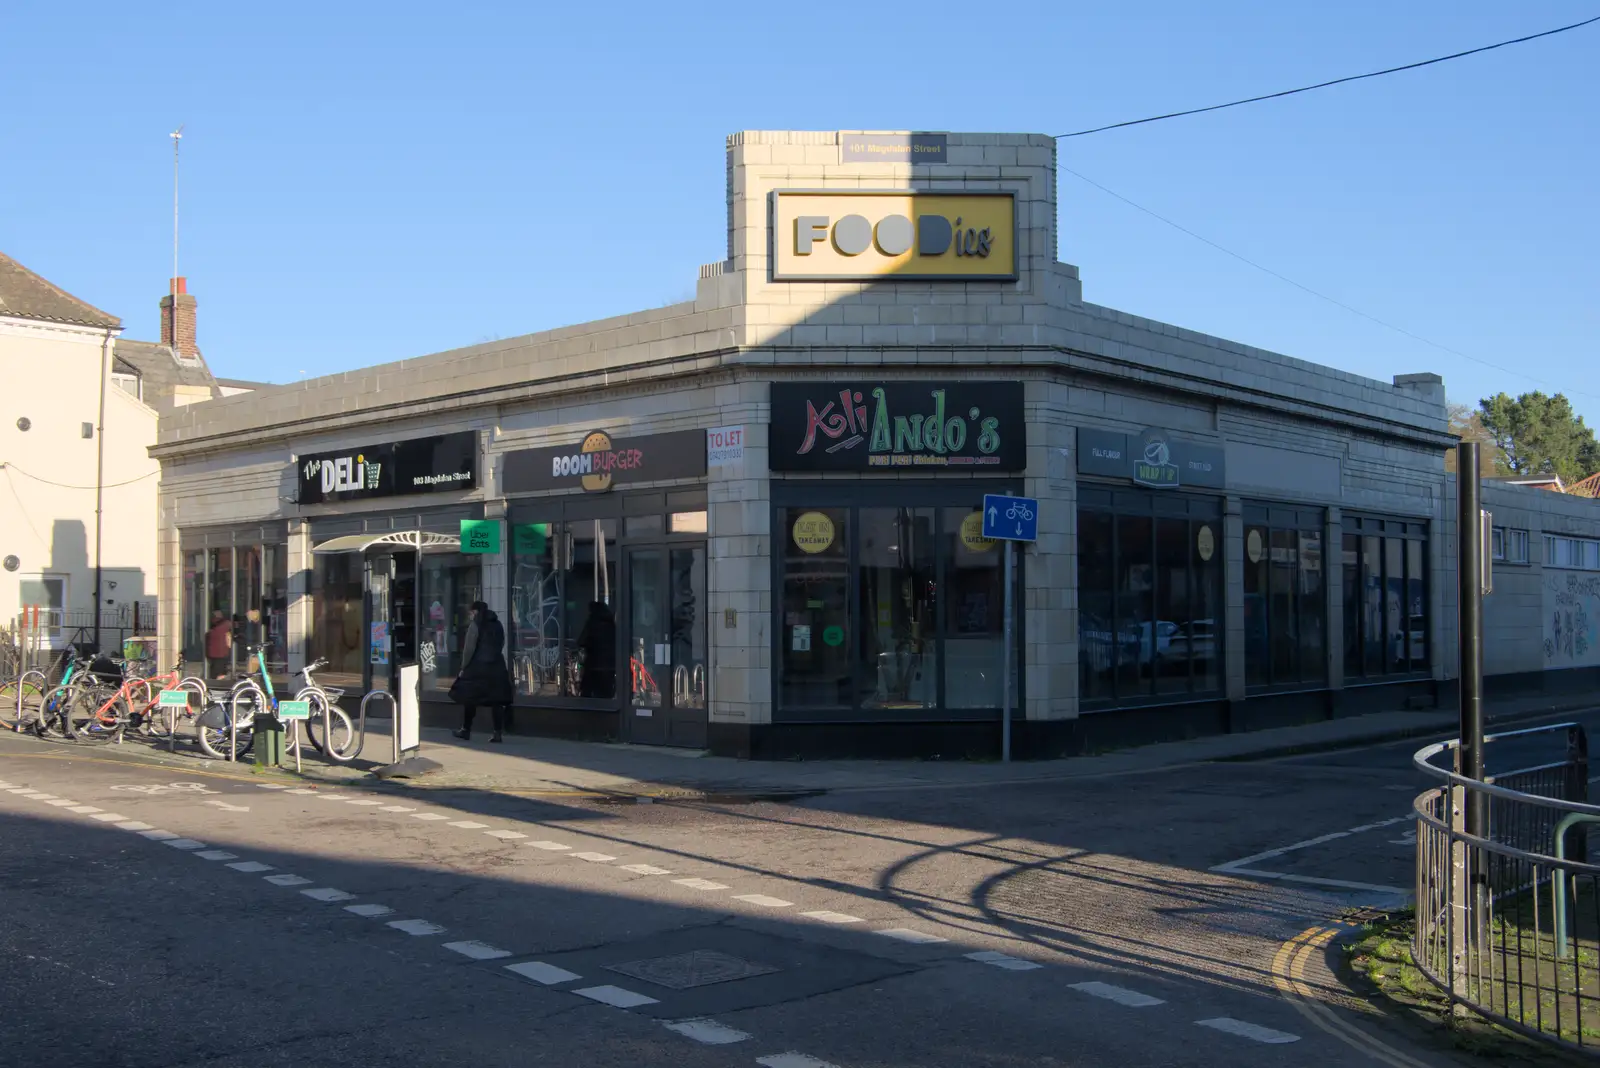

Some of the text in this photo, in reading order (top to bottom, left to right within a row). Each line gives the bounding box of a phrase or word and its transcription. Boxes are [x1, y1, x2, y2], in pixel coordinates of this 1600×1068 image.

[850, 144, 941, 155] 101 Magdalen Street
[708, 430, 742, 448] TO LET
[303, 459, 321, 481] The
[552, 448, 644, 477] BOOM BURGER
[413, 471, 471, 486] 103 Magdalen Street
[1139, 464, 1160, 480] WRAP
[470, 529, 489, 538] Uber
[818, 521, 829, 533] IN
[470, 539, 490, 548] Eats
